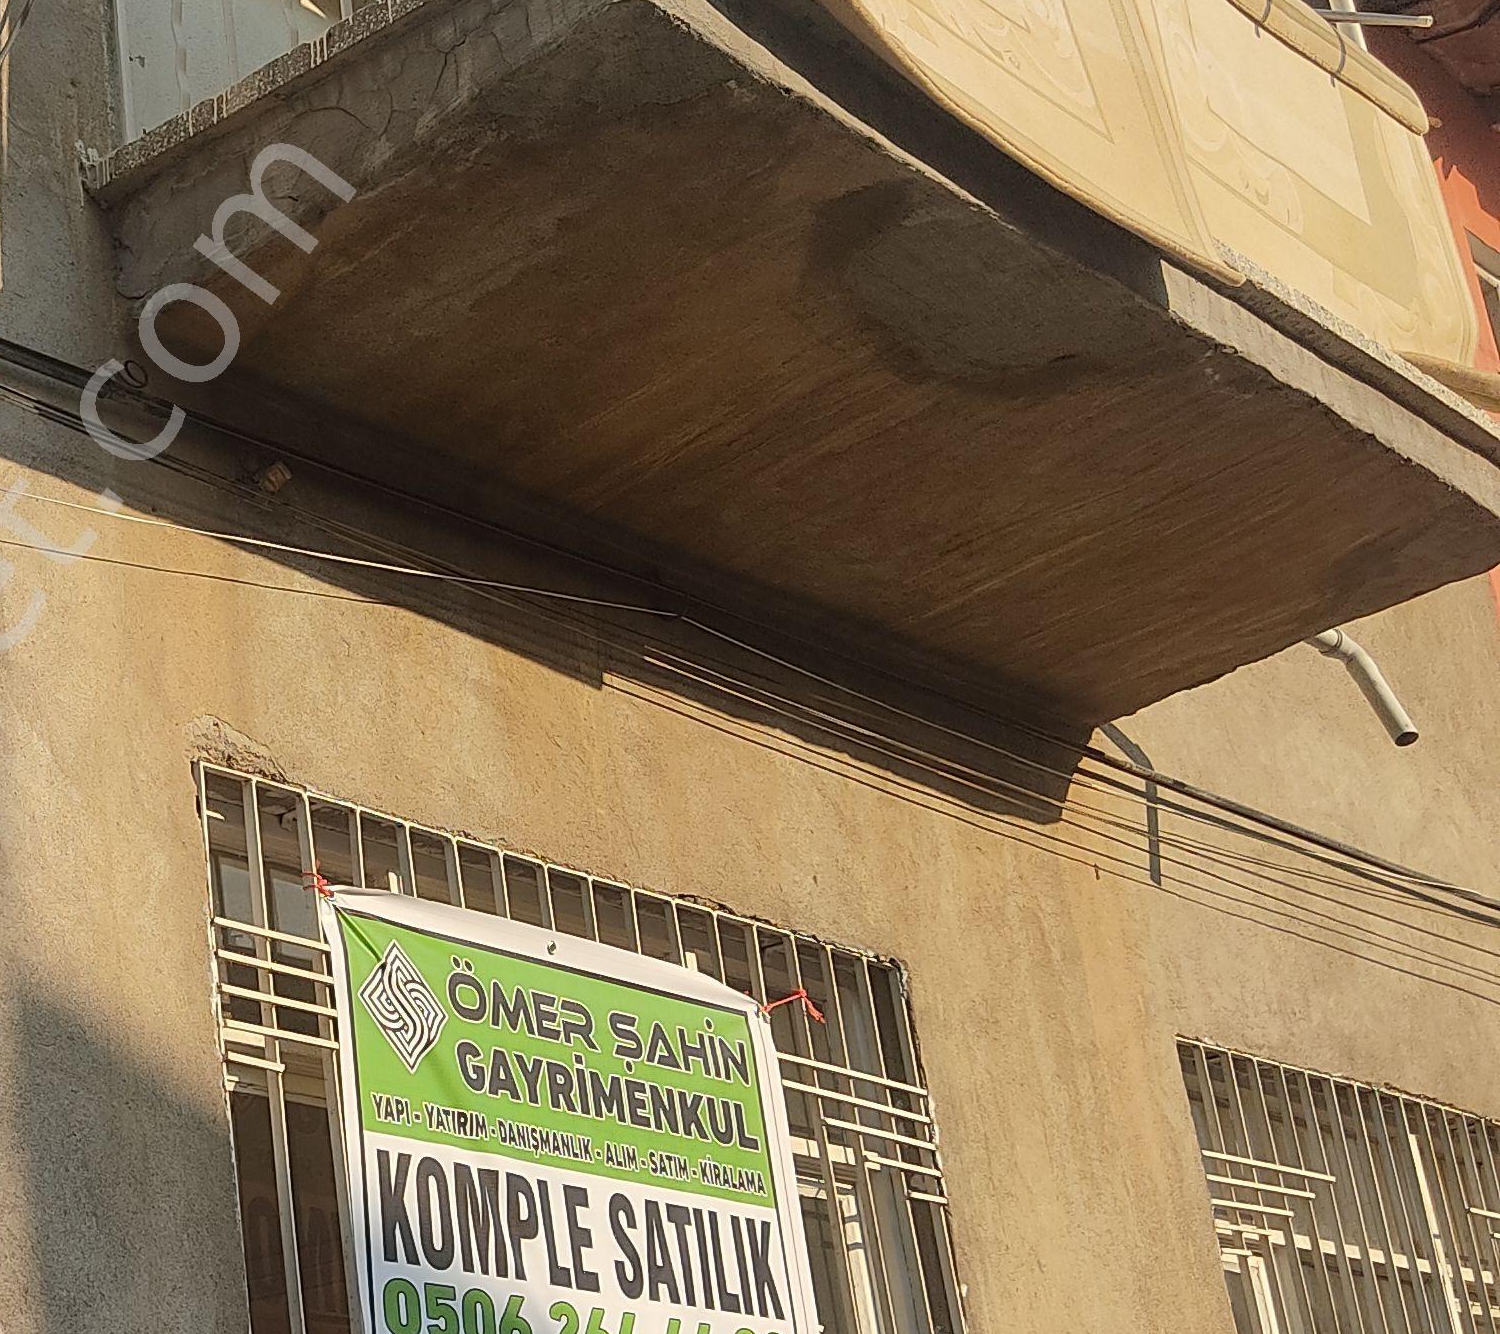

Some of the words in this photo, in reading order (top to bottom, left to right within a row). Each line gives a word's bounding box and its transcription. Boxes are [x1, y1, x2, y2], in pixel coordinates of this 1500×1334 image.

[446, 955, 600, 1053] ÖMER
[607, 1011, 751, 1086] ŞAHİN
[372, 1094, 411, 1126] YAPI
[424, 1102, 489, 1139] YATIRIM
[497, 1119, 594, 1162] DANIŞMANLIK
[605, 1141, 639, 1171] ALIM
[649, 1150, 690, 1181] SATIM
[699, 1154, 767, 1196] KİRALAMA
[455, 1040, 760, 1152] GAYRİMENKUL
[376, 1149, 602, 1292] KOMPLE
[608, 1192, 786, 1321] SATILIK
